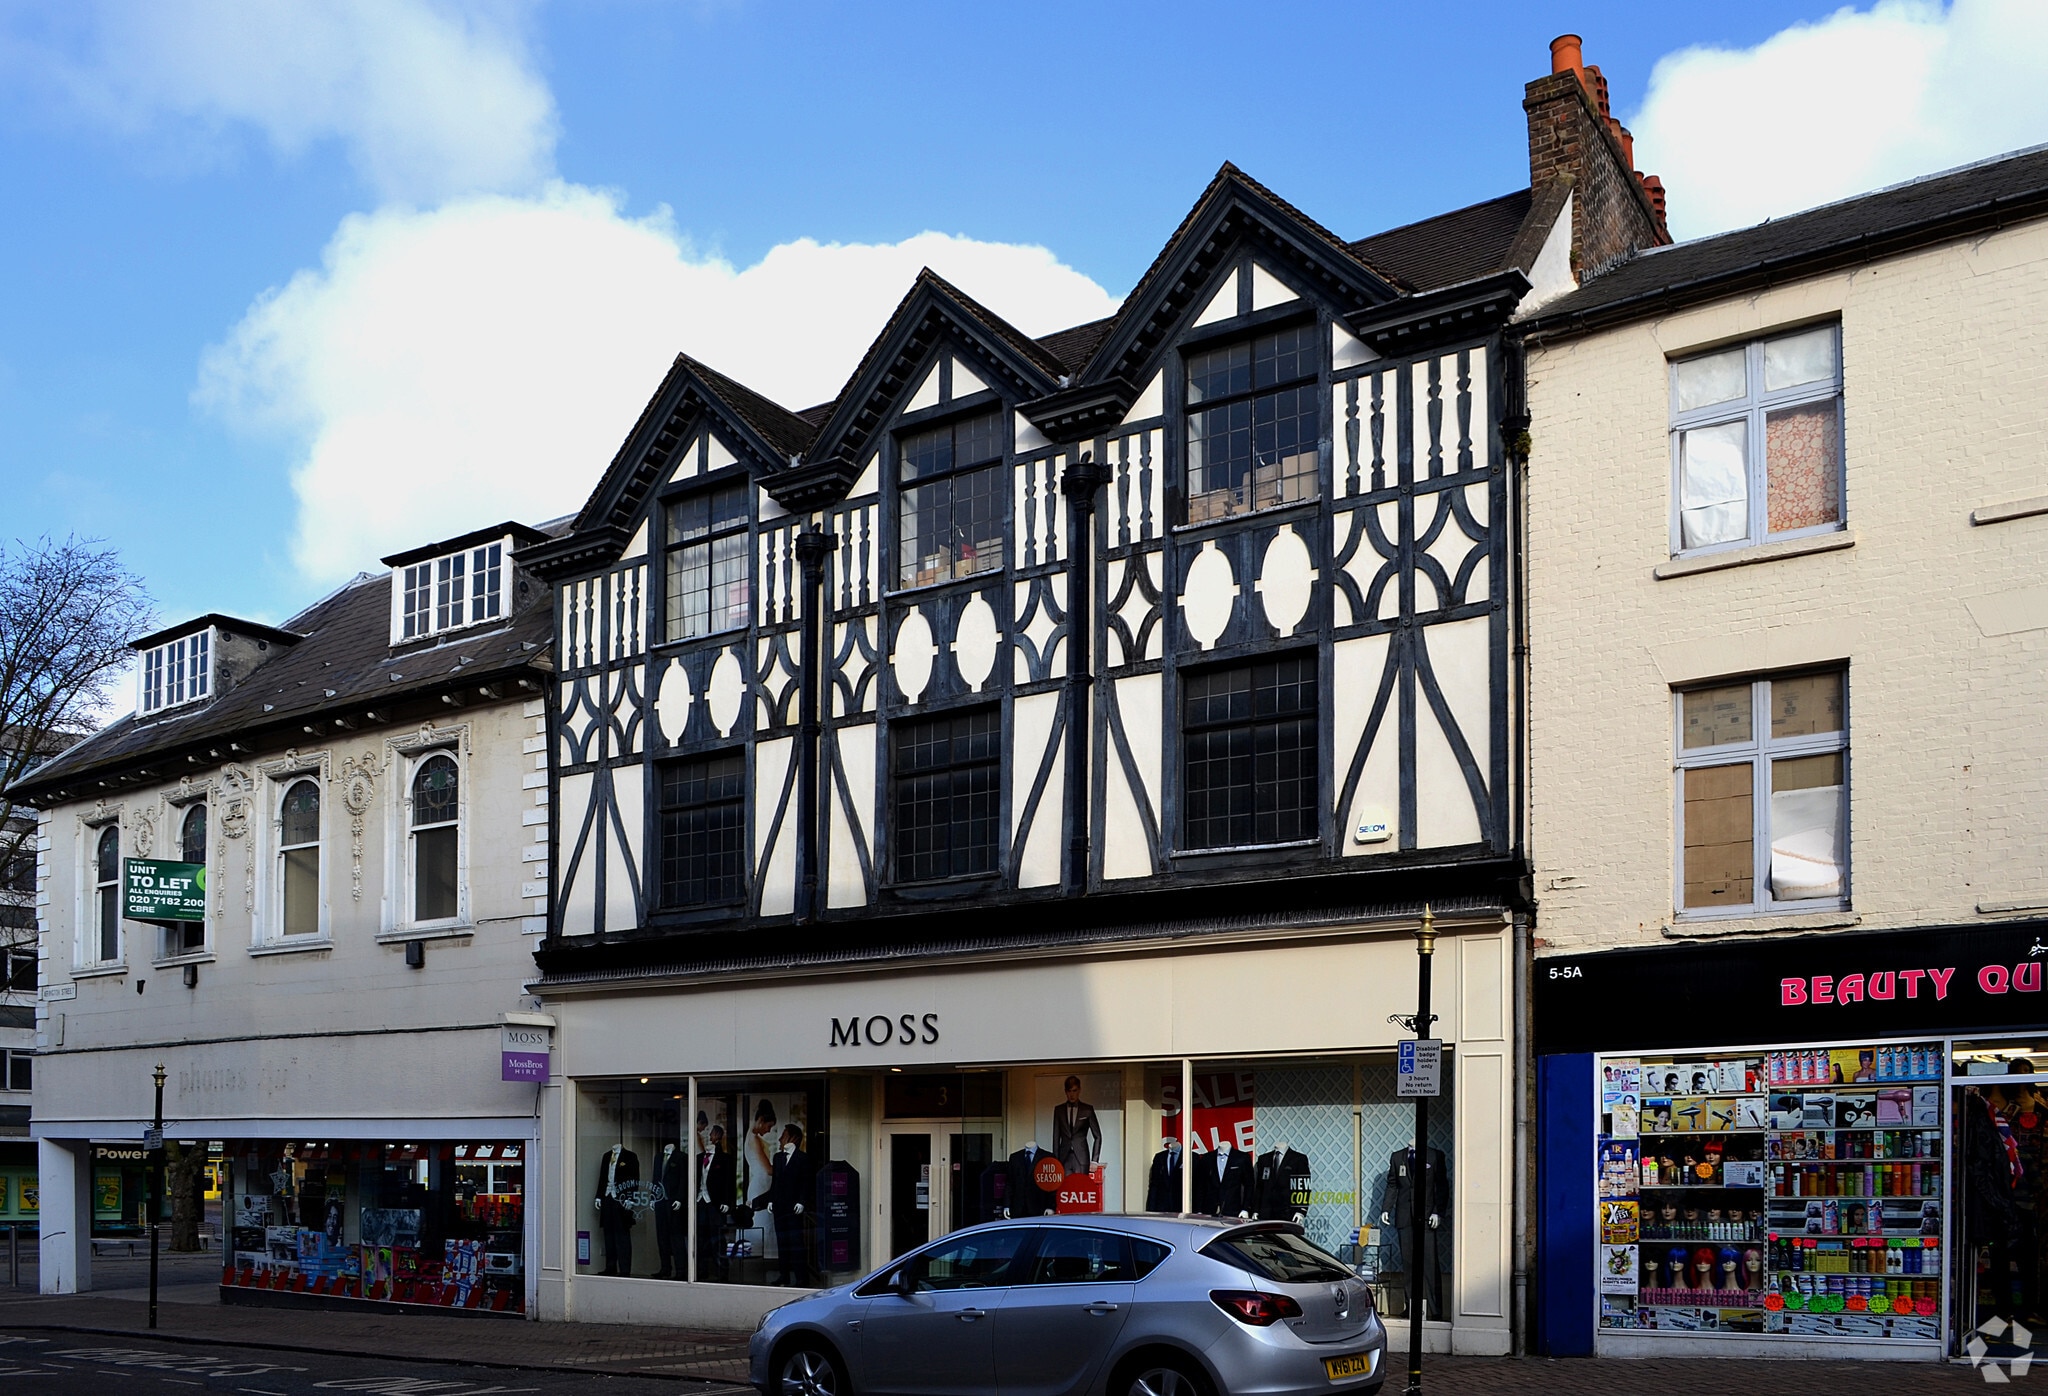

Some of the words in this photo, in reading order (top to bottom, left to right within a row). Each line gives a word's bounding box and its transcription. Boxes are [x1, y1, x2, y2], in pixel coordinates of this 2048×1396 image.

[129, 865, 157, 874] UNIT
[130, 875, 154, 887] TO
[159, 877, 192, 889] LET
[129, 895, 150, 903] 020
[153, 897, 180, 905] 7182
[183, 898, 206, 907] 200
[129, 905, 155, 913] CBRE
[1549, 966, 1583, 979] 5-5A
[1781, 967, 1956, 1006] BEAUTY
[828, 1013, 939, 1047] MOSS
[508, 1032, 543, 1044] MOSS
[1403, 1044, 1413, 1056] P
[508, 1058, 543, 1069] MossBros
[938, 1086, 948, 1106] 3
[1161, 1069, 1254, 1117] SALE
[96, 1147, 149, 1159] Power
[1043, 1163, 1056, 1173] MID
[1036, 1173, 1062, 1183] SEASON
[1290, 1178, 1312, 1190] NEW
[1060, 1191, 1097, 1204] SALE
[1290, 1191, 1356, 1204] COLLECTIONS
